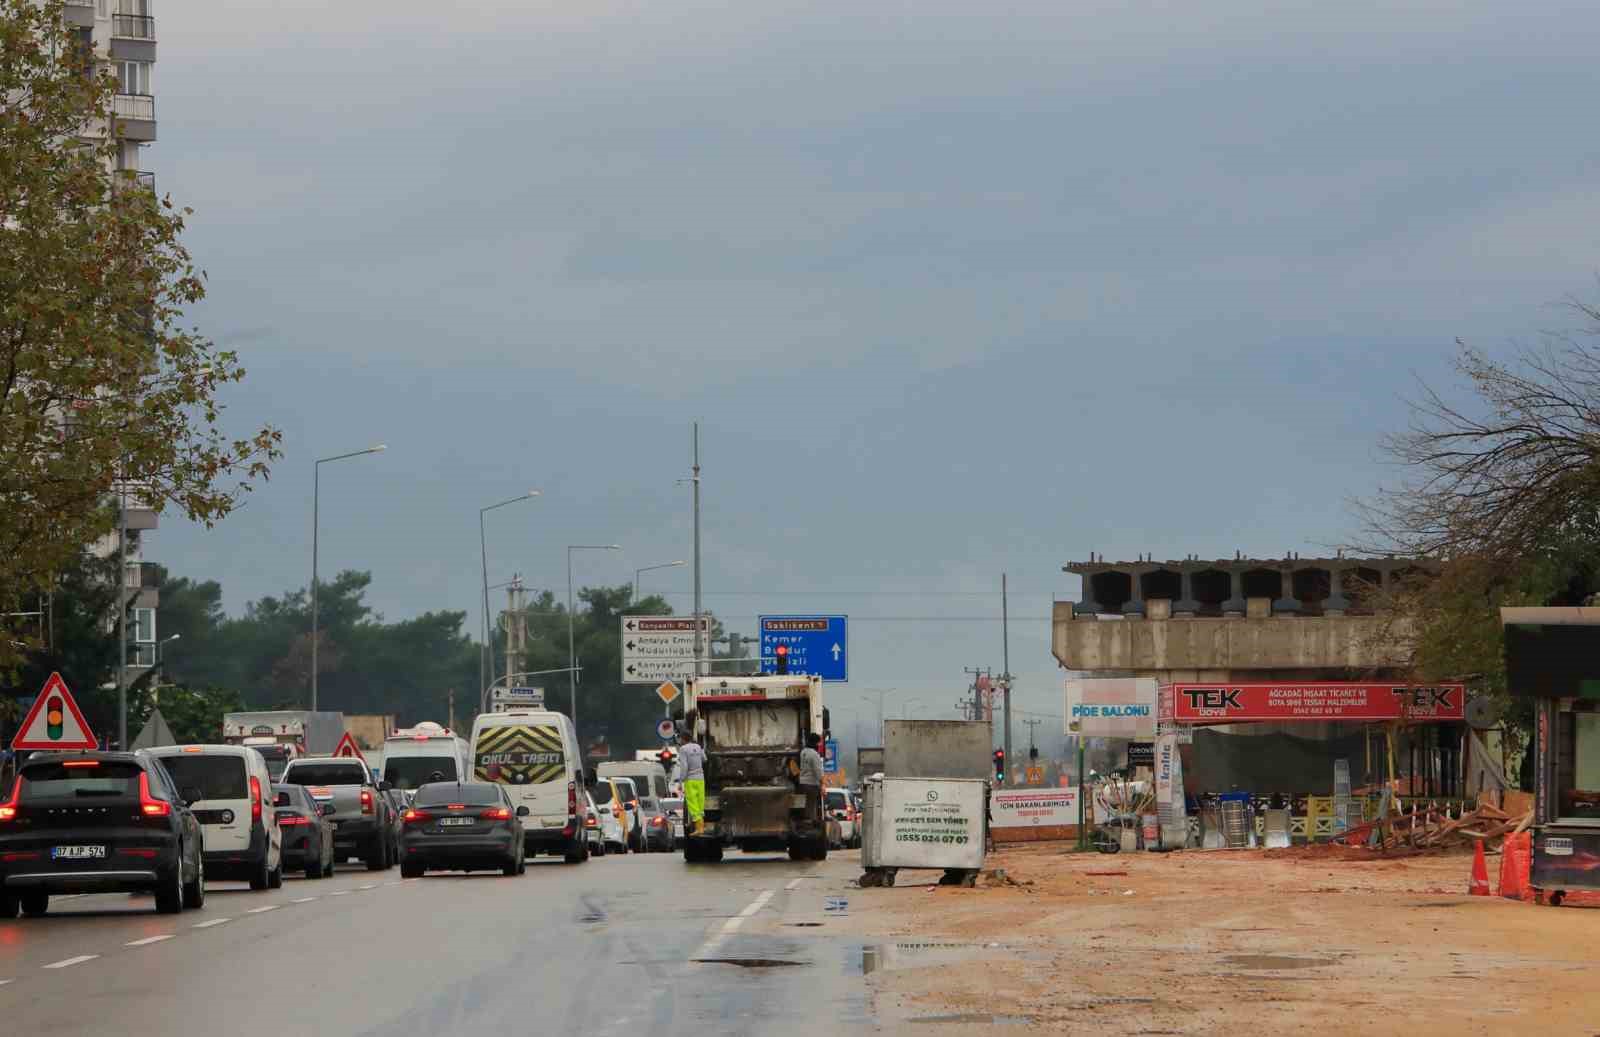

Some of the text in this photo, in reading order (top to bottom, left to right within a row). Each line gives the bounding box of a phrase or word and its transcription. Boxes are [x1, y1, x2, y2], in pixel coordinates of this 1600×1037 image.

[638, 636, 669, 645] Antalya
[764, 634, 803, 643] Kemer
[638, 646, 692, 656] Müdürlüğü
[764, 646, 808, 655] Budur
[764, 657, 808, 666] Deizli
[1330, 689, 1356, 697] TİCARET
[1358, 689, 1368, 697] VE
[1183, 688, 1244, 710] TEK
[1072, 703, 1150, 717] PİDE SALONU
[481, 752, 560, 765] OKUL TAŞITI
[943, 816, 969, 825] YÖNET
[896, 834, 920, 842] 0555
[942, 835, 955, 844] 07
[956, 835, 969, 844] 07
[57, 847, 67, 857] 07
[88, 847, 105, 857] 574
